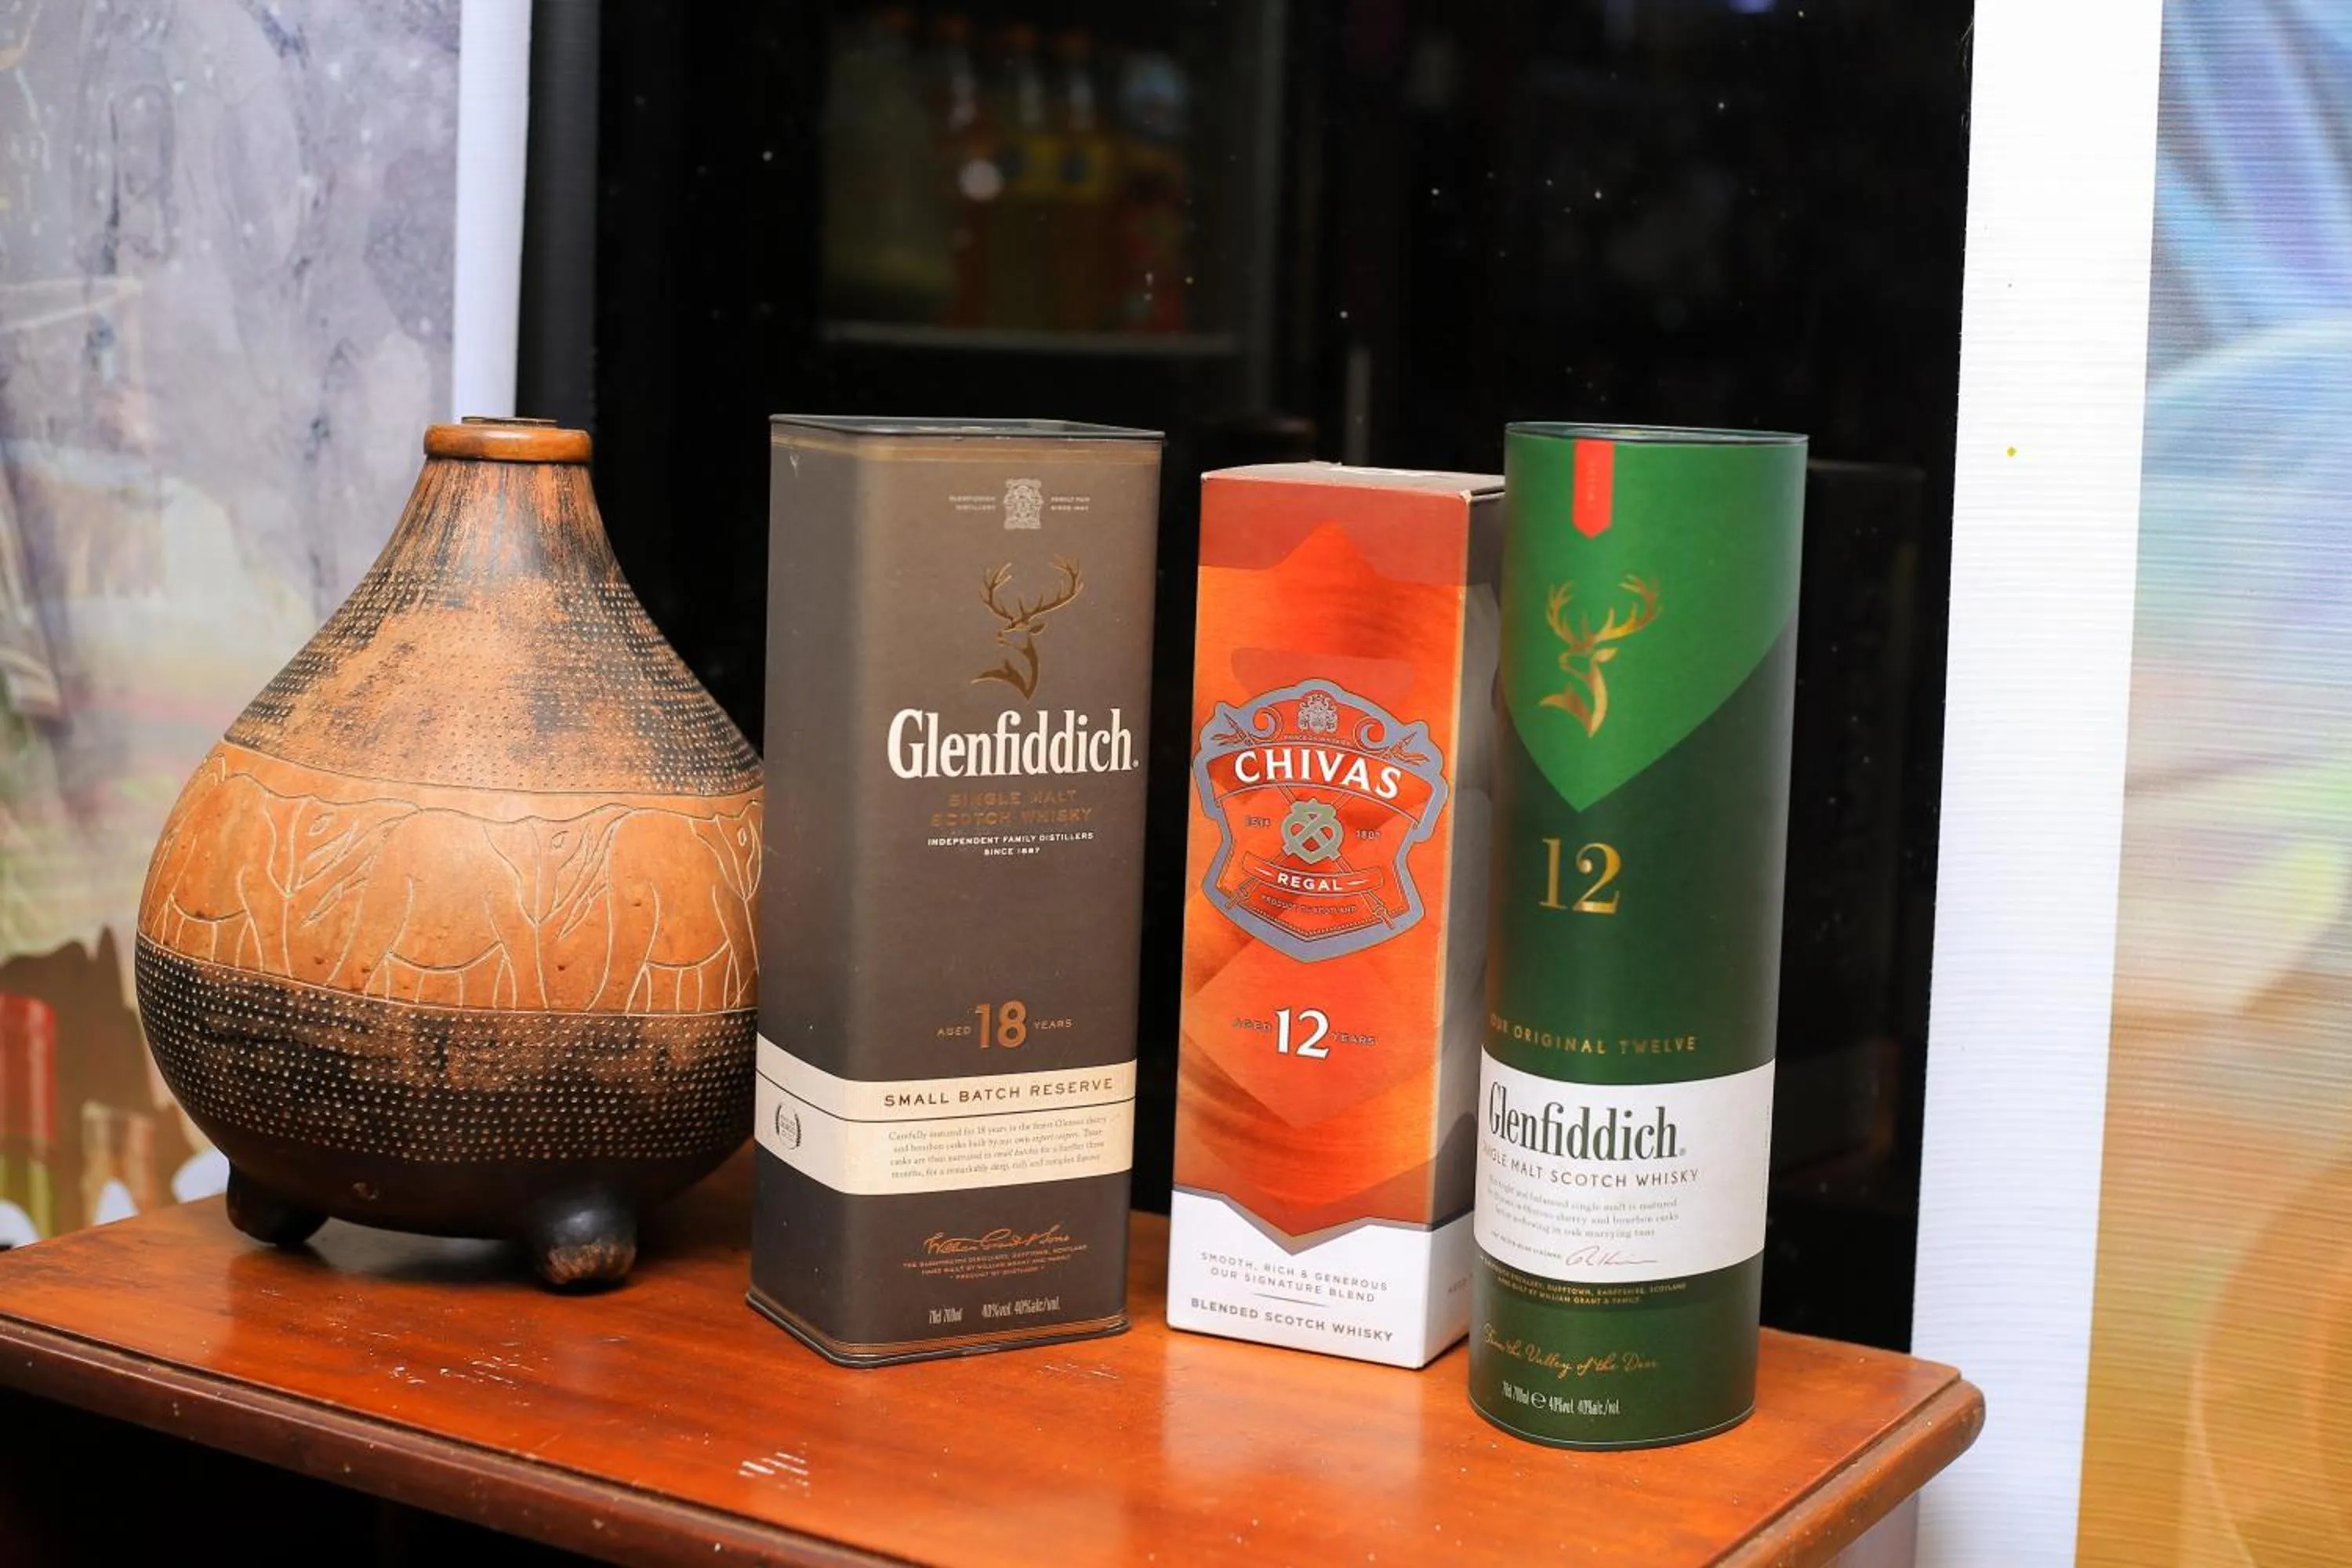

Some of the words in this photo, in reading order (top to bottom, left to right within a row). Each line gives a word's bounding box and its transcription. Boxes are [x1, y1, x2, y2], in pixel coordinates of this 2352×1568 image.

[1234, 746, 1402, 800] CHIVAS
[948, 792, 1022, 808] SINGLE
[1030, 789, 1077, 804] MALT
[929, 812, 1012, 827] SCOTCH
[1022, 808, 1092, 824] WHISKY
[927, 836, 1000, 847] INDEPENDENT
[1002, 834, 1036, 844] FAMILY
[1039, 832, 1094, 842] DISTILLERS
[983, 847, 1014, 856] SINCE
[1276, 871, 1343, 891] REGAL
[1538, 837, 1623, 915] 12
[937, 1025, 971, 1037] AGED
[975, 1000, 1027, 1049] 18
[1034, 1019, 1073, 1030] YEARS
[1232, 1018, 1272, 1034] AGED
[1274, 1007, 1331, 1061] 12
[1331, 1032, 1377, 1046] YEARS
[1514, 1025, 1606, 1054] ORIGINAL
[1619, 1036, 1697, 1054] TWELVE
[884, 1091, 949, 1108] SMALL
[959, 1085, 1022, 1102] BATCH
[1030, 1077, 1113, 1098] RESERVE
[1511, 1158, 1543, 1180] MALT
[1550, 1170, 1627, 1189] SCOTCH
[1635, 1167, 1700, 1187] WHISKY
[1200, 1251, 1257, 1270] SMOOTH,
[1263, 1264, 1295, 1278] RICH
[1300, 1269, 1308, 1279] &
[1314, 1271, 1388, 1292] GENEROUS
[1210, 1266, 1238, 1280] OUR
[1244, 1272, 1323, 1295] SIGNATURE
[1329, 1288, 1376, 1303] BLEND
[1191, 1298, 1259, 1319] BLENDED
[1265, 1311, 1326, 1331] SCOTCH
[1332, 1323, 1394, 1342] WHISKY
[1524, 1343, 1574, 1380] Valley
